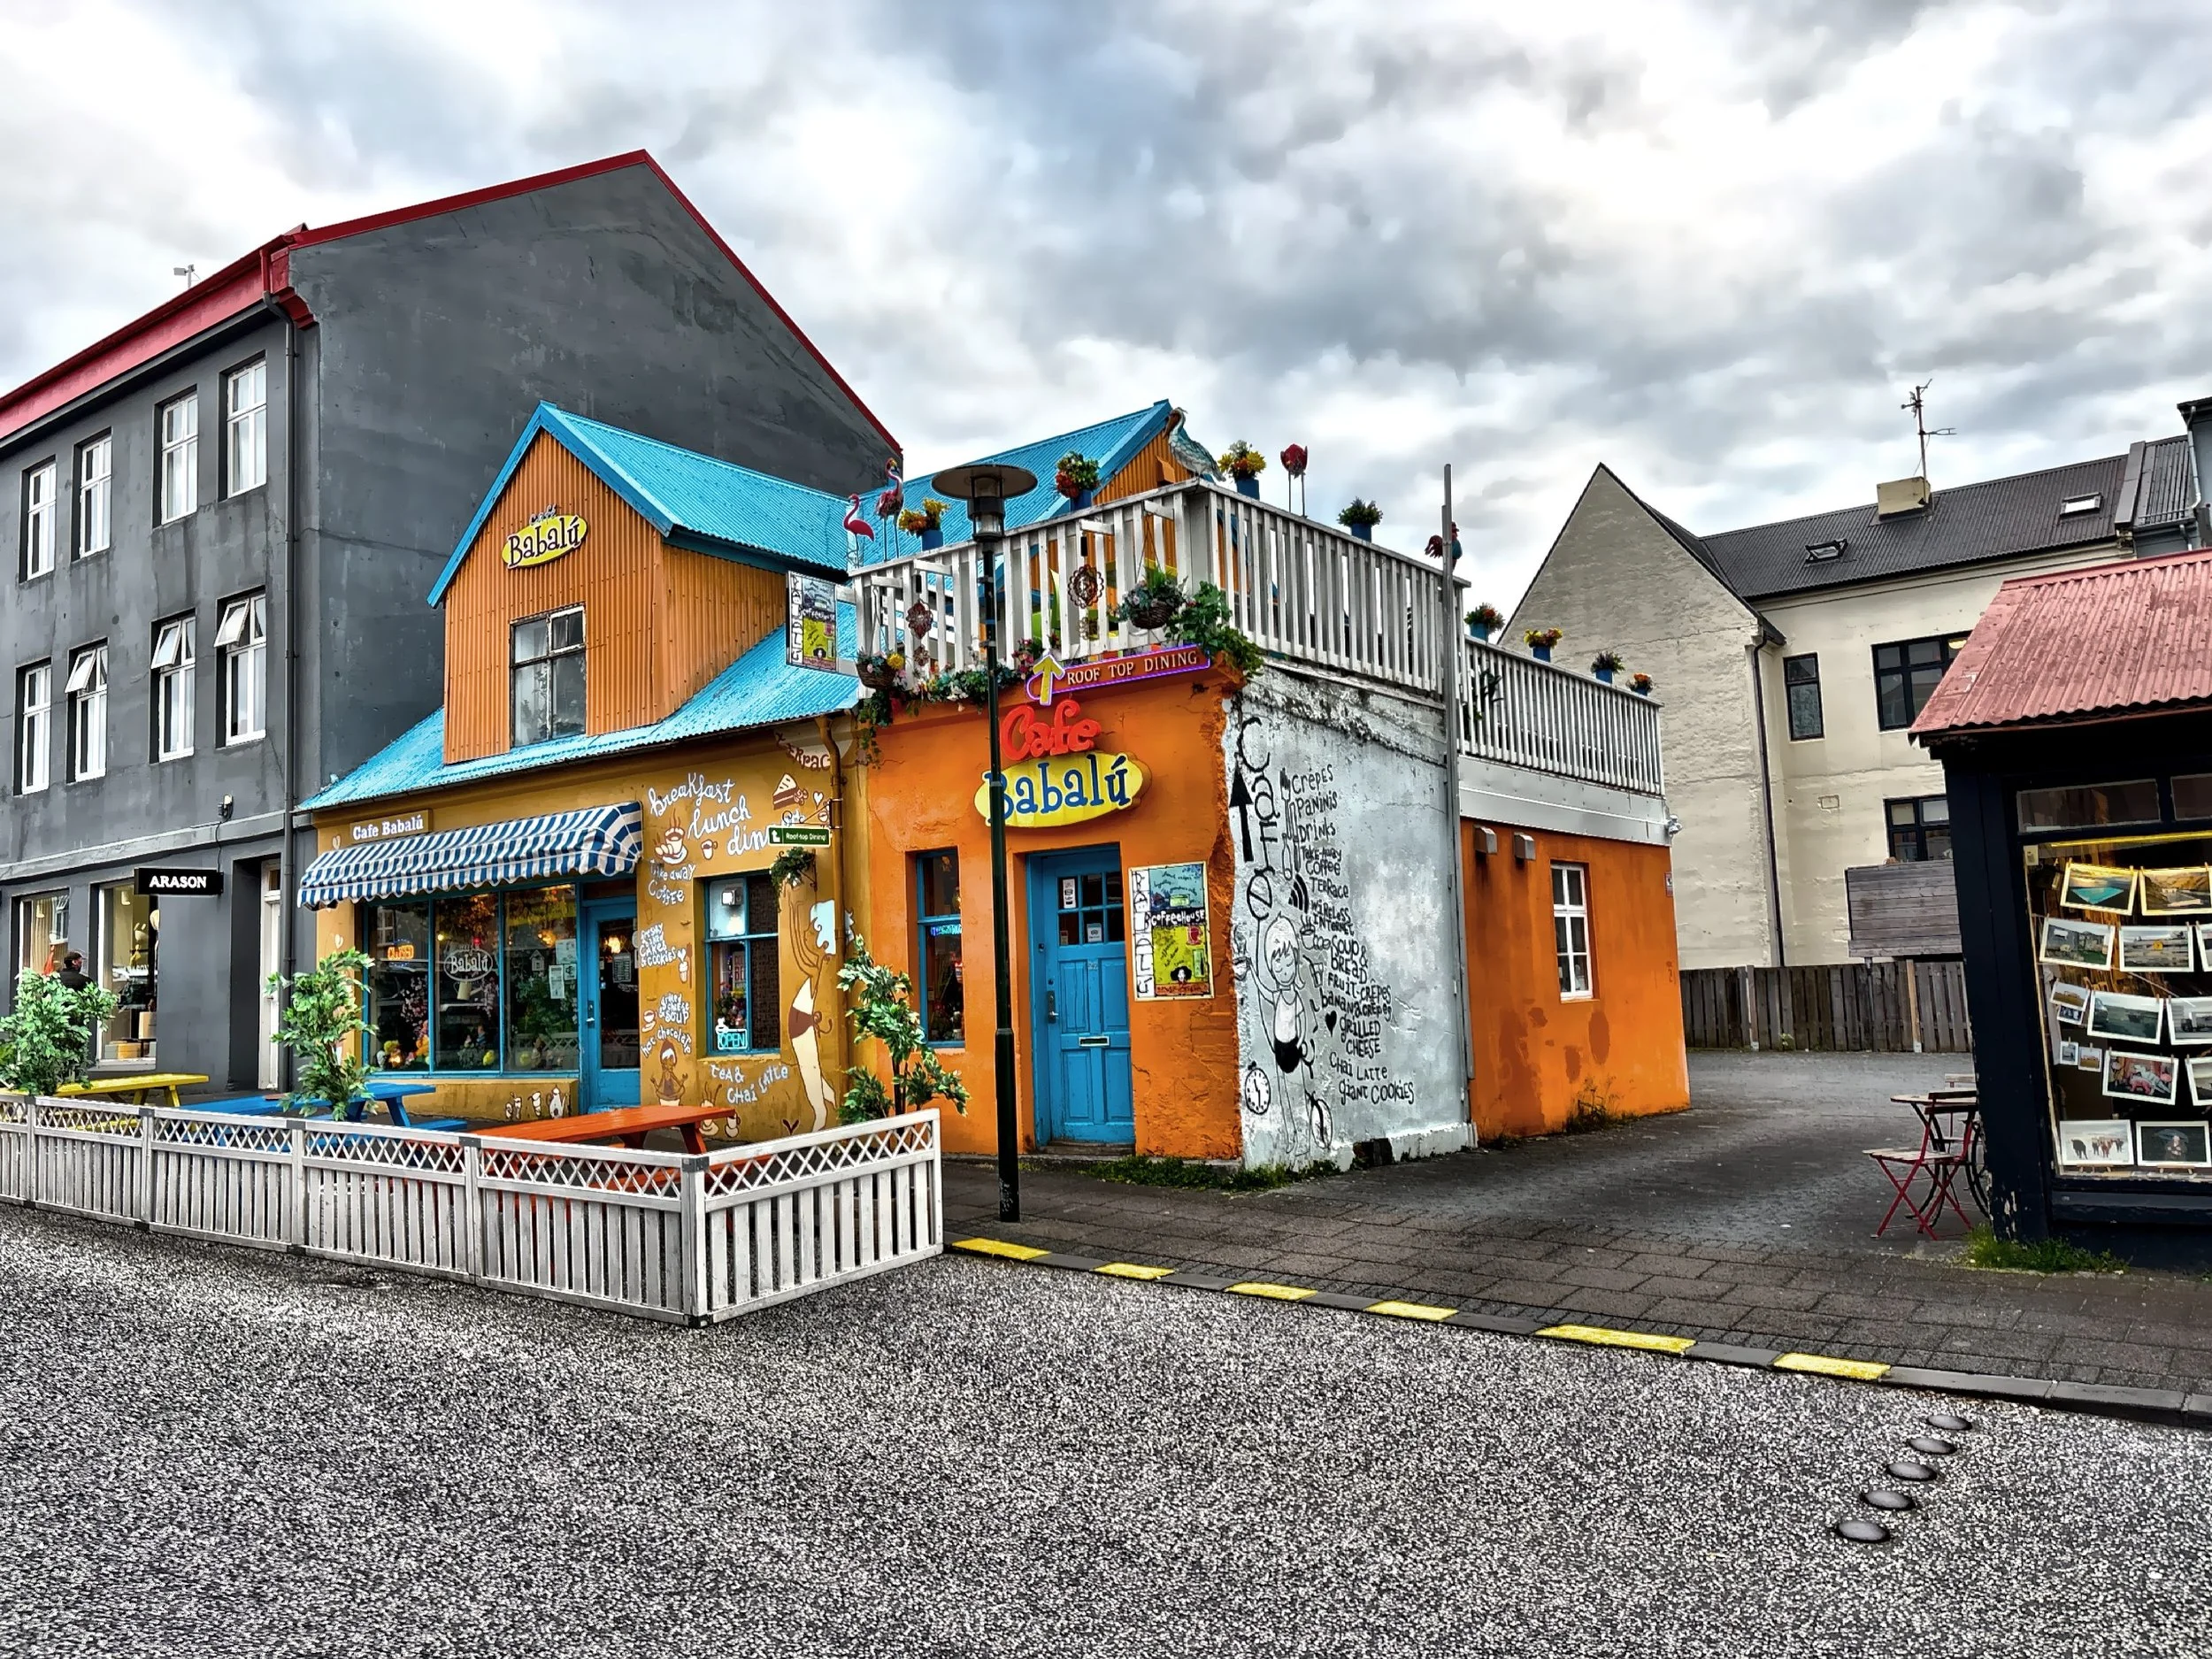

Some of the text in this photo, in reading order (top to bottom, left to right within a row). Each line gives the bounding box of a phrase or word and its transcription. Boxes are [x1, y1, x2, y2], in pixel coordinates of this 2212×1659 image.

[508, 516, 580, 567] Babalú
[1067, 650, 1197, 685] ROOF TOP DINING
[1001, 699, 1102, 761] Cafe
[352, 814, 424, 840] Cafe Babalú
[687, 795, 752, 840] lunch
[149, 875, 207, 888] ARASON
[450, 952, 488, 974] Babalú
[1359, 945, 1368, 969] &
[720, 1033, 745, 1048] OPEN
[735, 1066, 745, 1084] &
